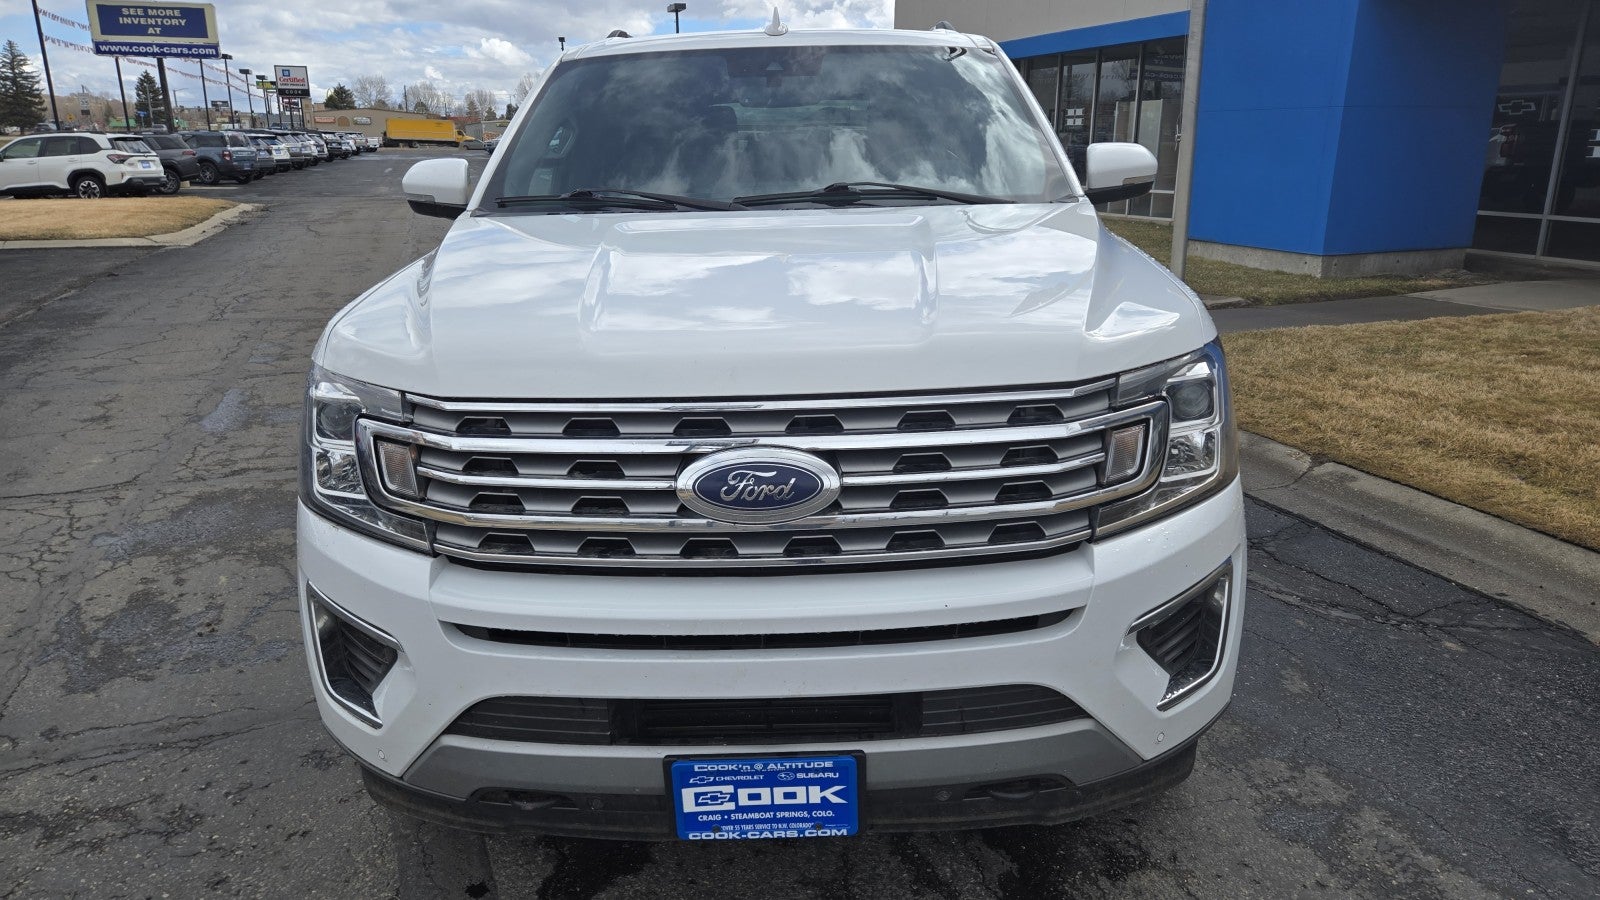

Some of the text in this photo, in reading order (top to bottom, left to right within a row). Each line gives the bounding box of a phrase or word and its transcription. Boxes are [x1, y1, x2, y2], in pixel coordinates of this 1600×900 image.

[119, 17, 187, 26] INVENTORY
[147, 27, 162, 35] AT
[99, 44, 216, 55] www.cook-cars.com
[719, 470, 797, 501] Ford
[766, 761, 834, 770] ALTITUDE
[681, 785, 849, 813] COOK
[697, 810, 835, 822] CRAIG STEAMBOAT SPRINGS, COLO.
[688, 829, 848, 840] COOK-CARS.COM
